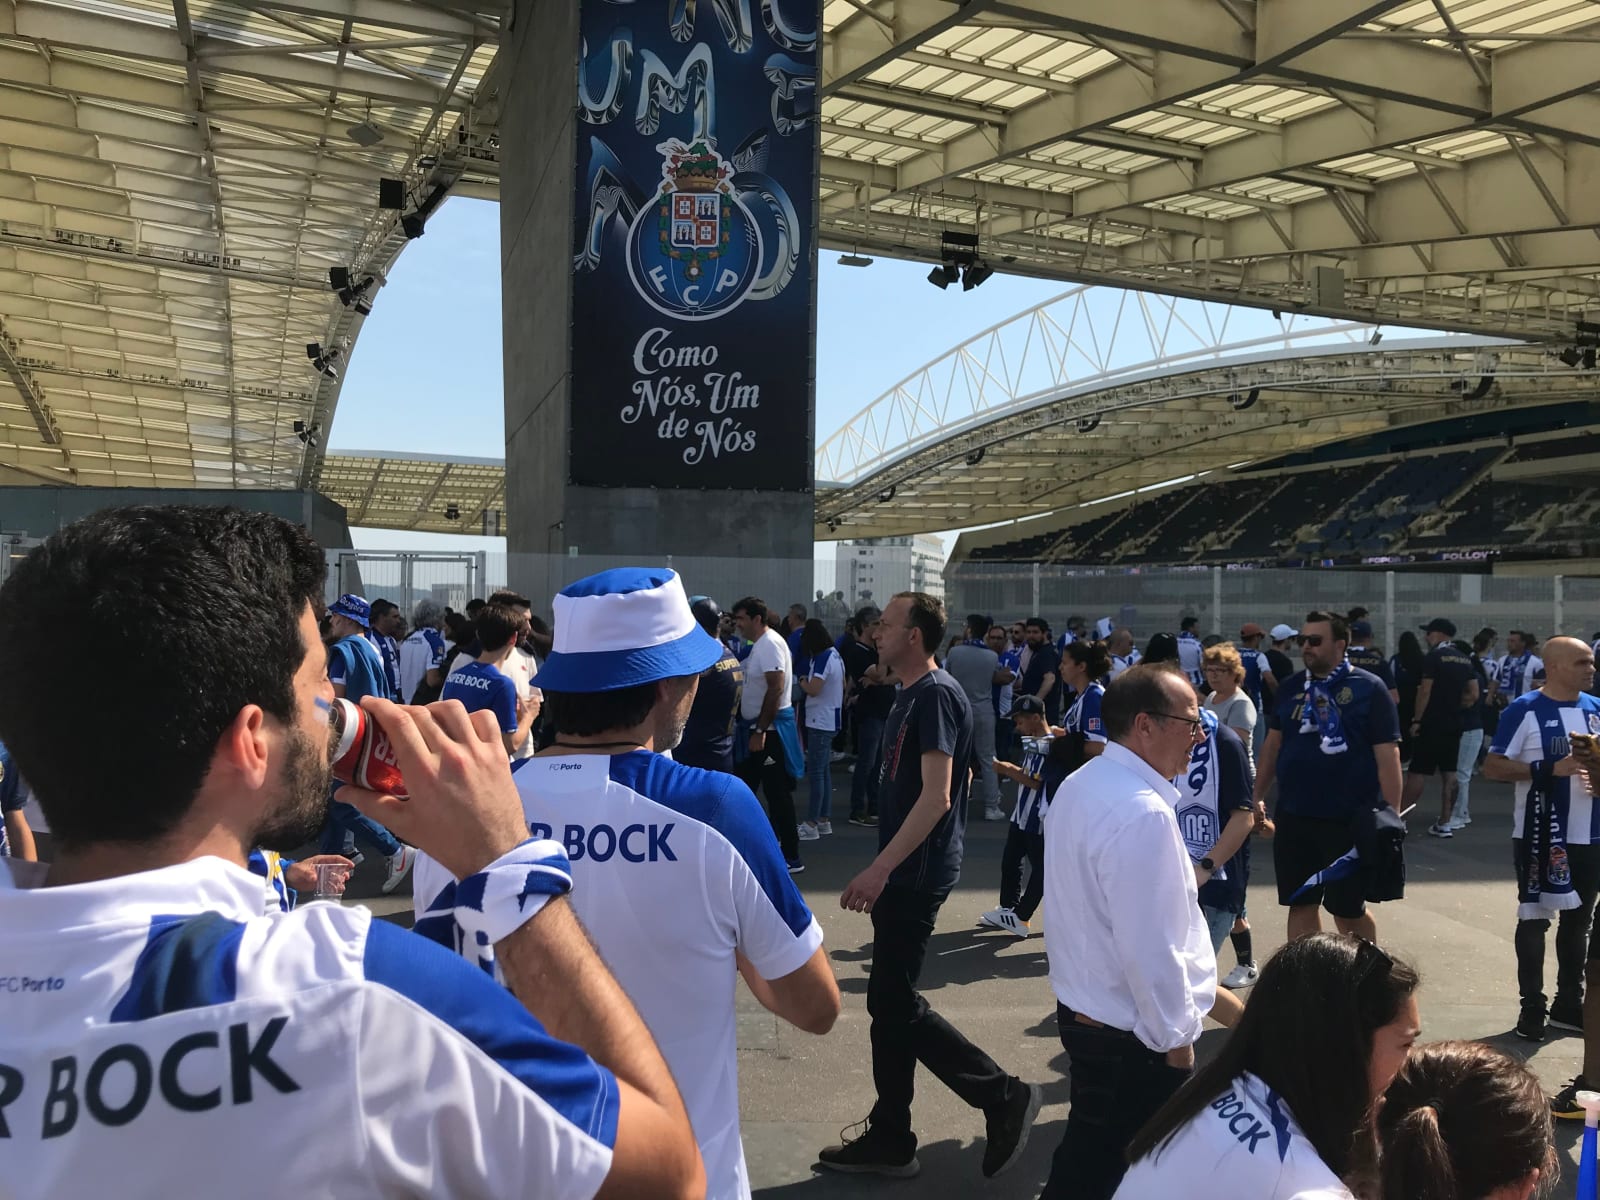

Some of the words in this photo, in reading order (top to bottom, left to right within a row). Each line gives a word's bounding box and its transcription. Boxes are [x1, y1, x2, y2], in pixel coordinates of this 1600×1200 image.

[632, 327, 719, 375] Como
[620, 376, 701, 424] Nós,
[703, 371, 760, 414] Um
[657, 409, 689, 438] de
[682, 417, 757, 465] Nós
[464, 675, 491, 691] BOCK
[560, 763, 582, 771] Porto
[563, 823, 678, 863] BOCK
[21, 976, 66, 993] Porto
[41, 1016, 303, 1140] BOCK
[1211, 1091, 1272, 1154] BOCK
